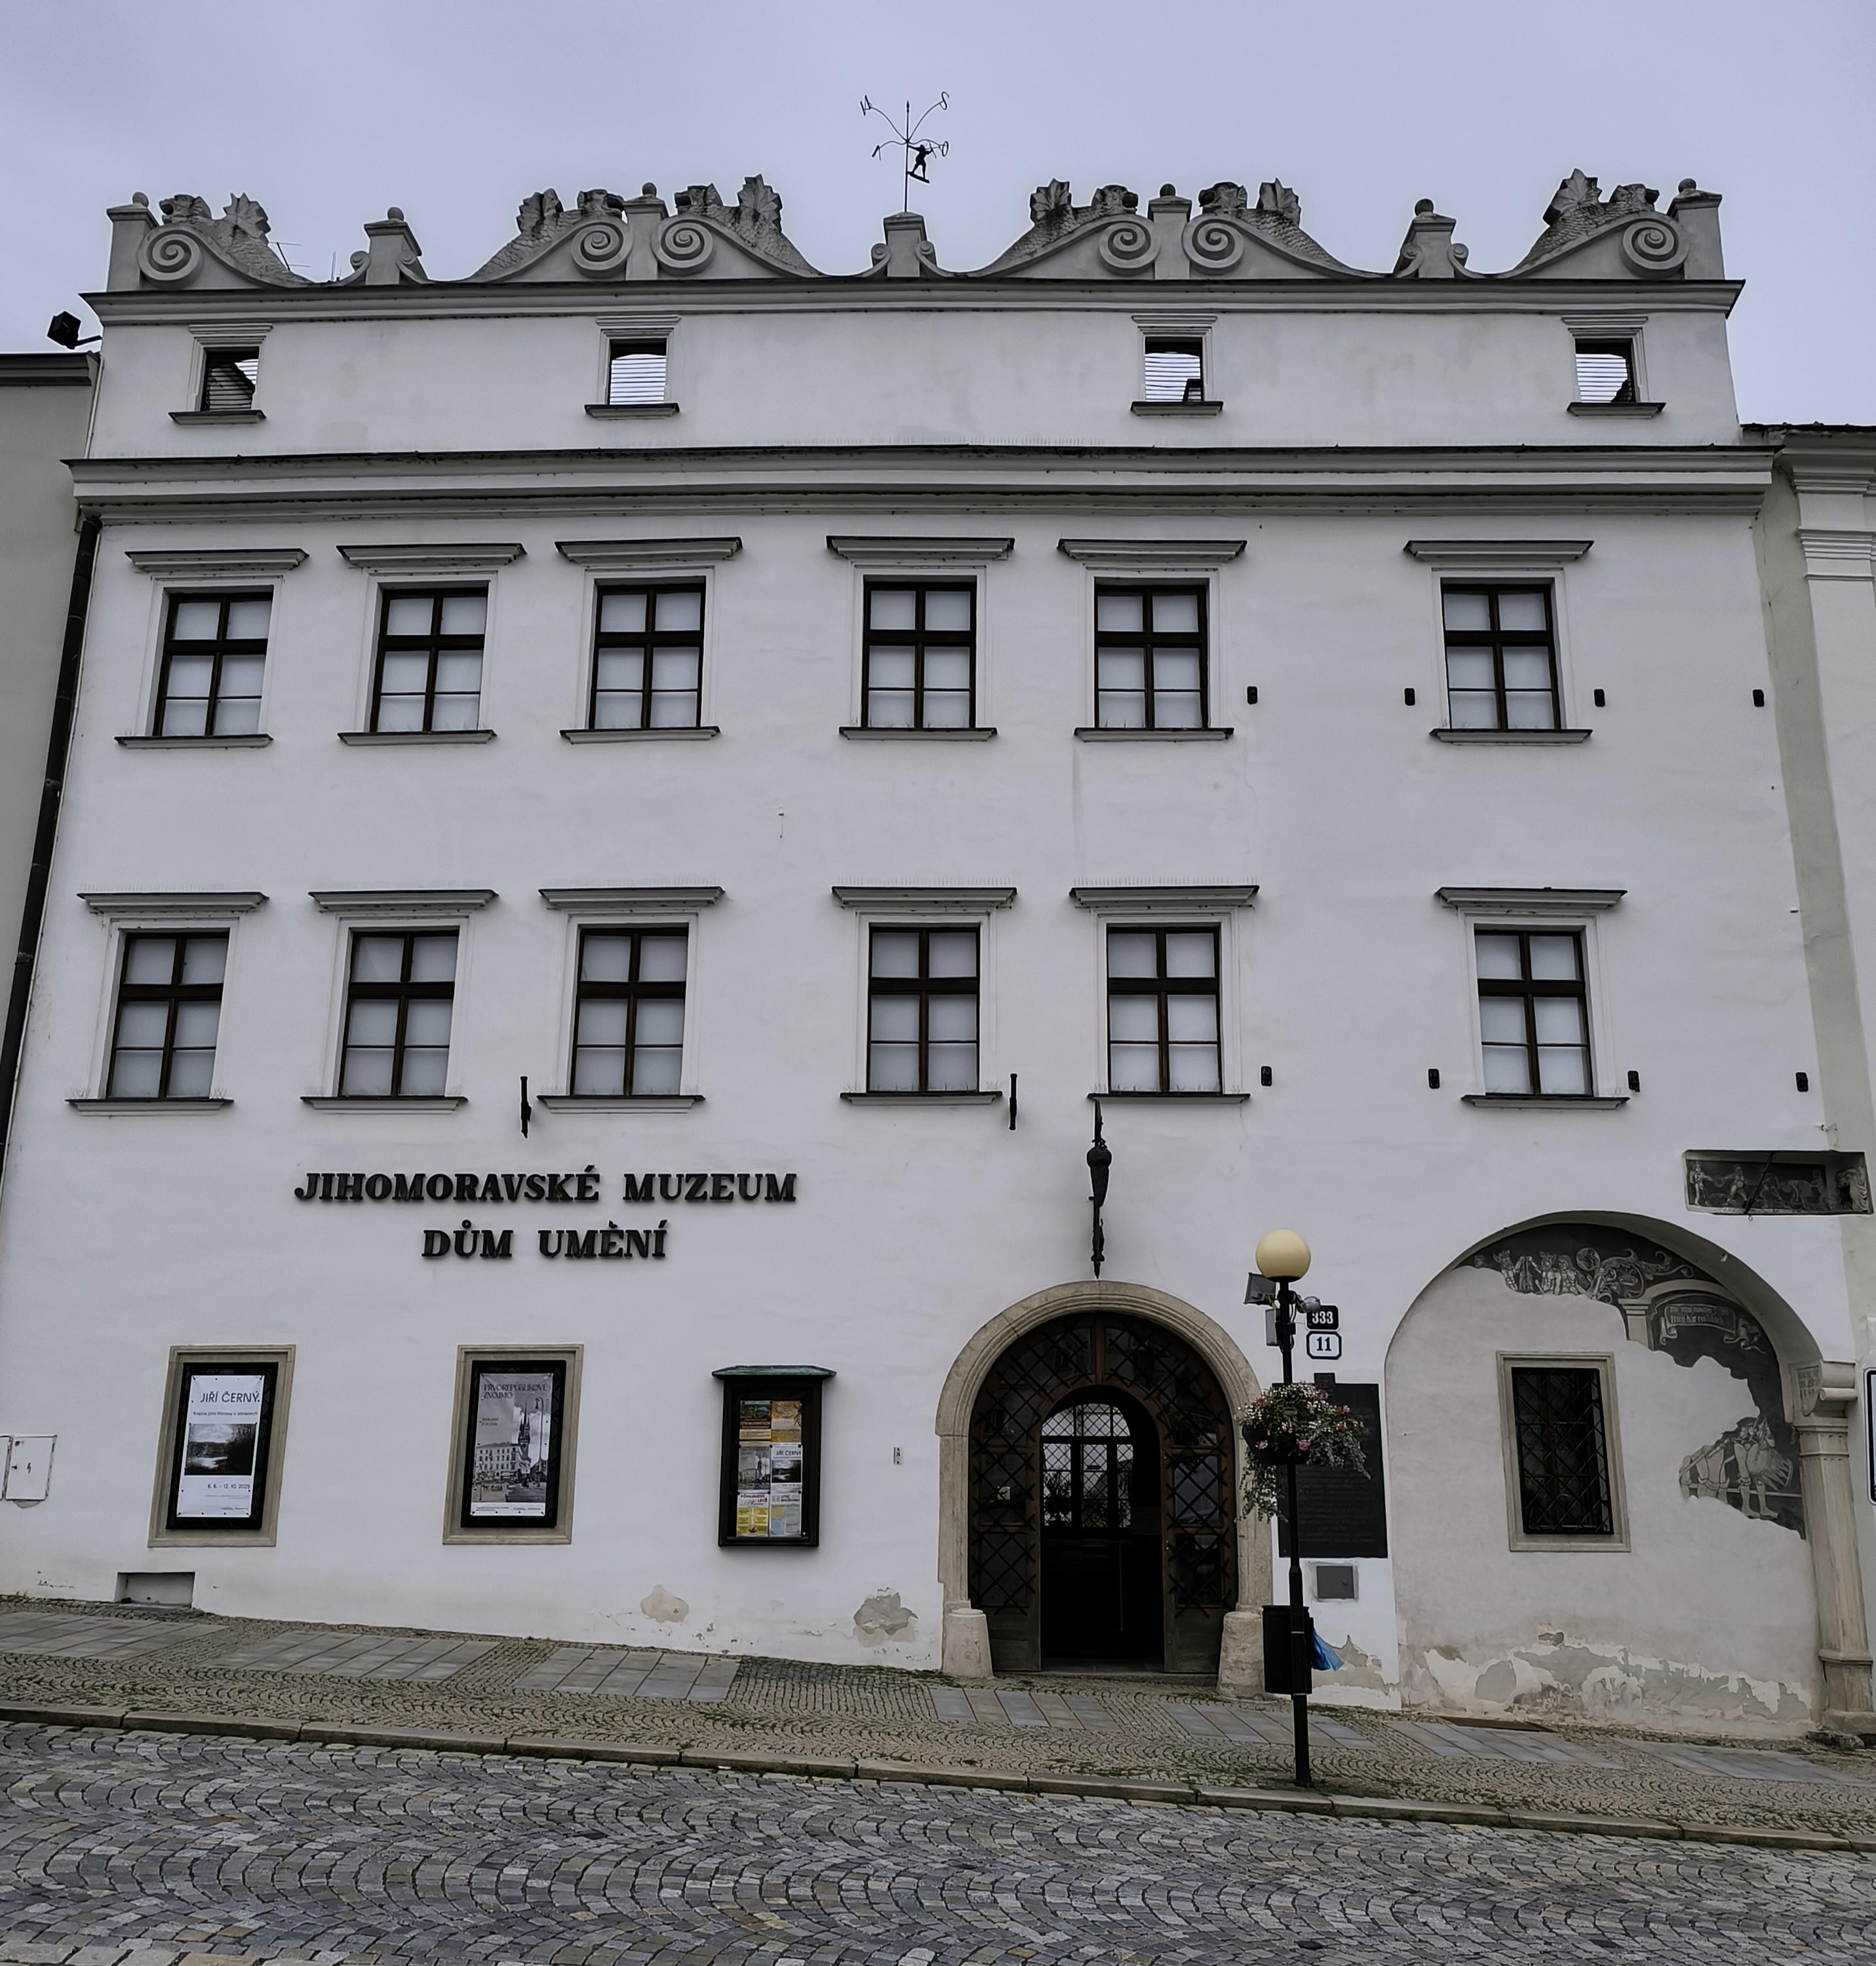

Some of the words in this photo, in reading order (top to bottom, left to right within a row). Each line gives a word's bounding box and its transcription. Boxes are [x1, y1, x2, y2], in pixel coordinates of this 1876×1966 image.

[294, 1165, 599, 1202] JIHOMORAVSKÉ
[623, 1173, 797, 1202] MUZEUM
[421, 1220, 514, 1258] DŮM
[537, 1219, 670, 1259] UMĚNÍ
[1312, 1311, 1333, 1324] 333
[1316, 1336, 1332, 1351] 11
[200, 1391, 219, 1403] JIŘÍ
